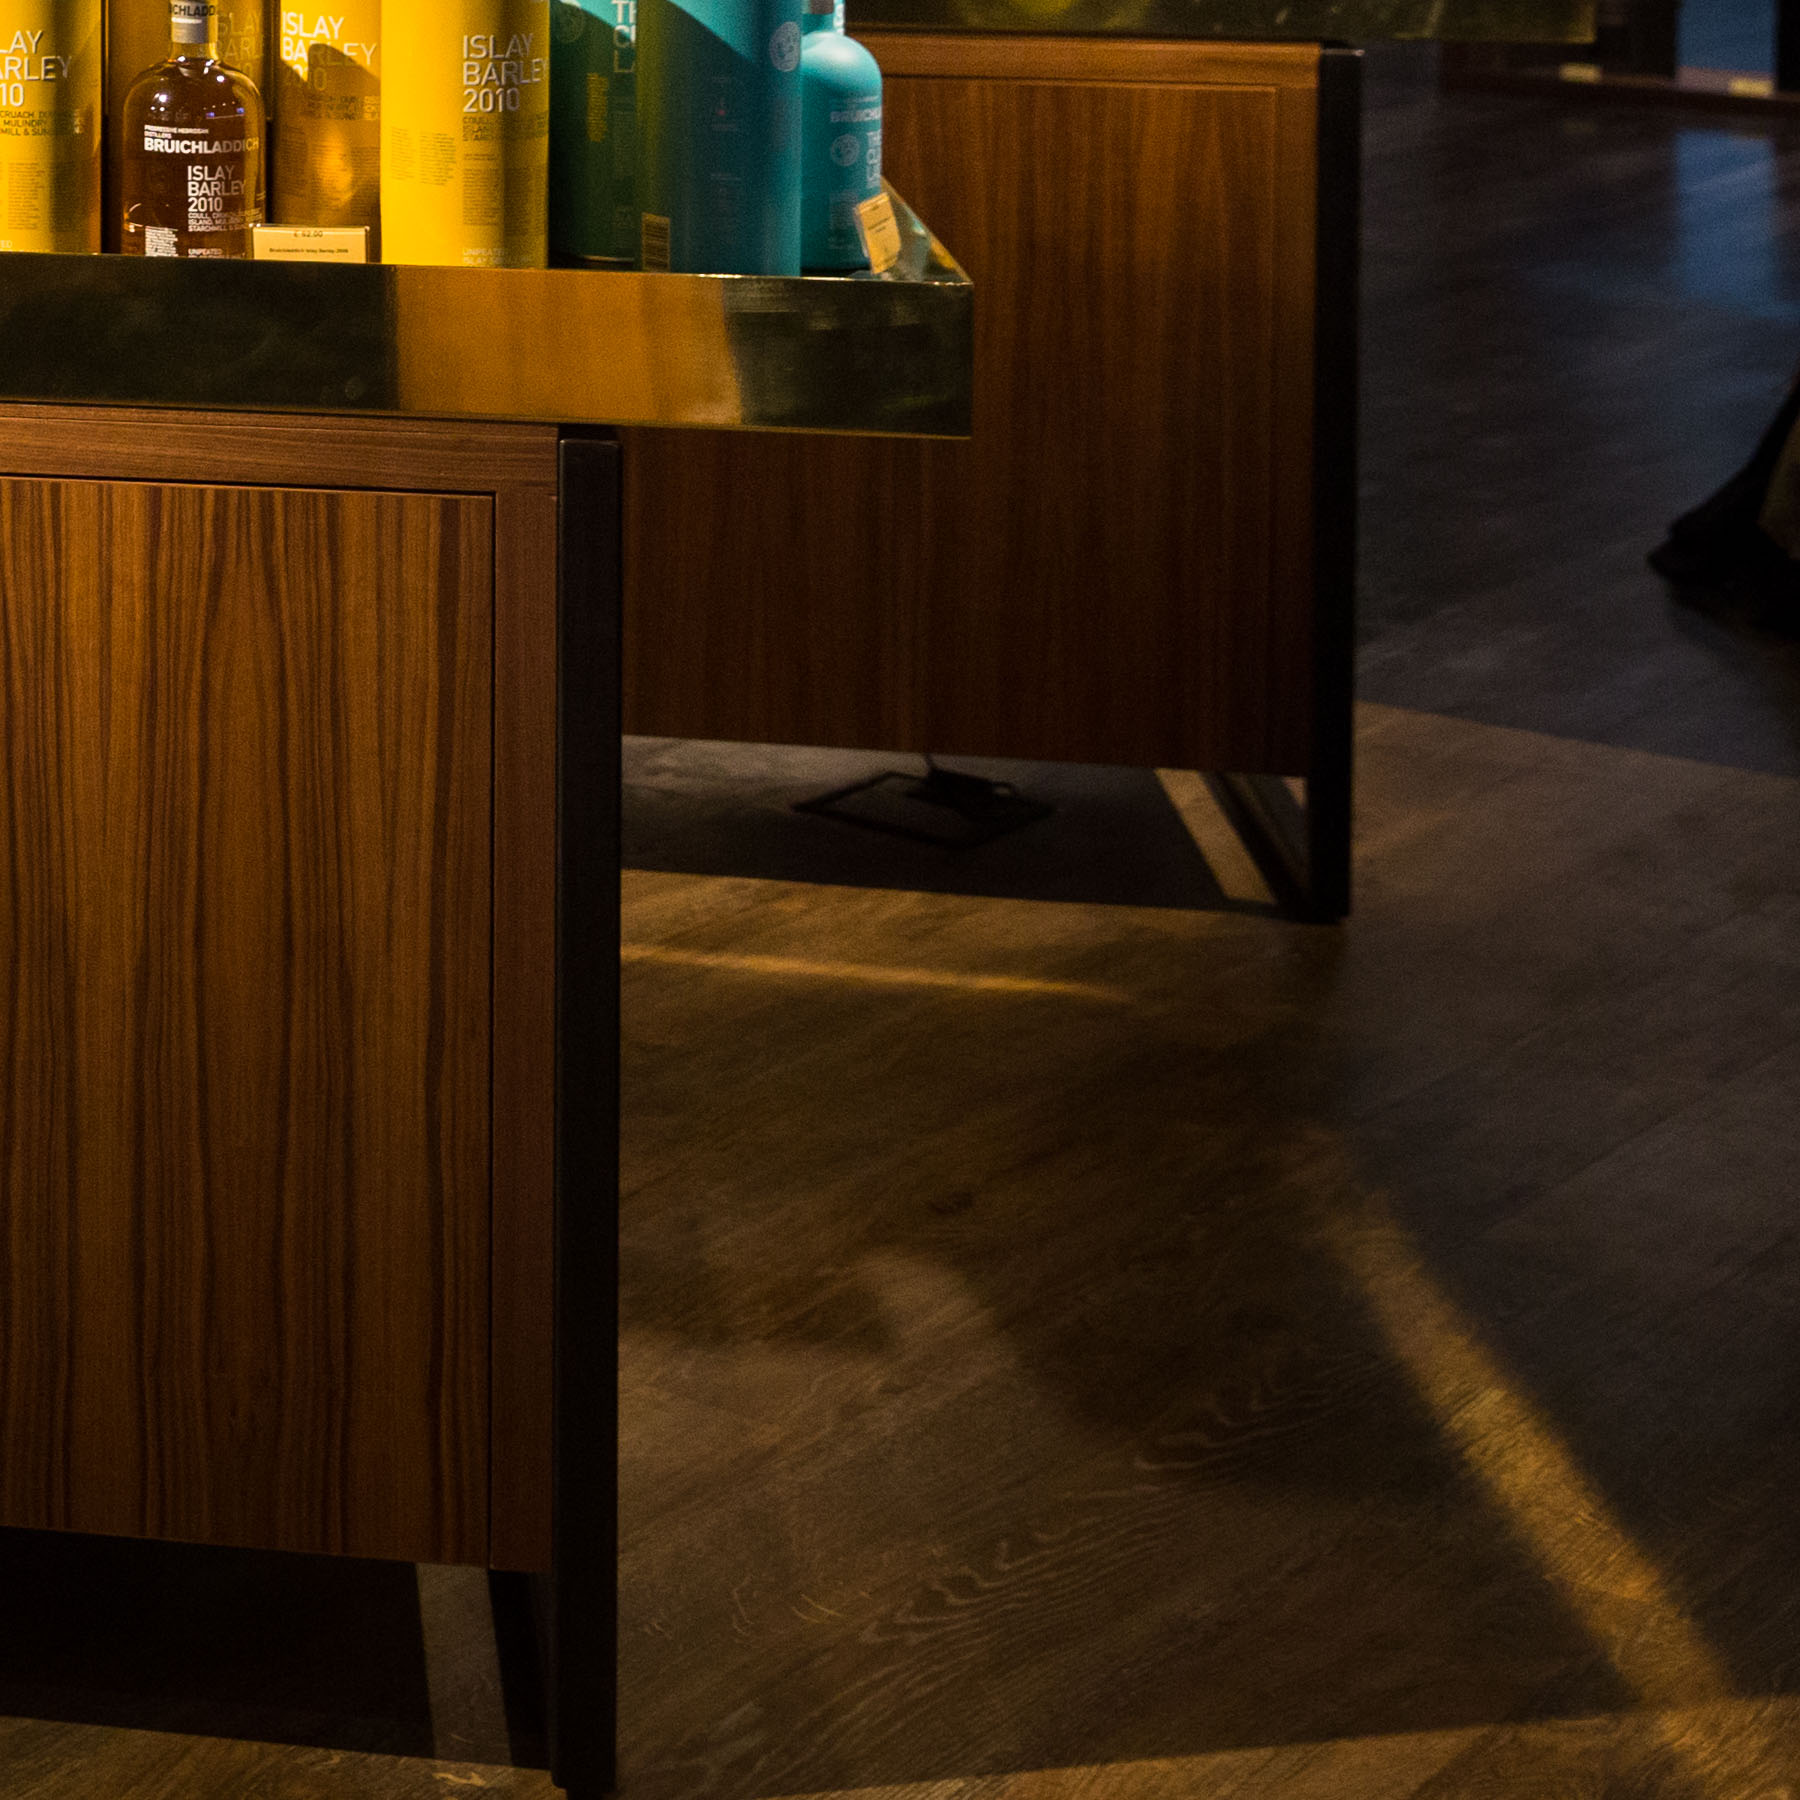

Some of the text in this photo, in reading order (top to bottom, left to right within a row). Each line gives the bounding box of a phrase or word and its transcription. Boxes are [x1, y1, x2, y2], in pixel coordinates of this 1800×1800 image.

[282, 11, 345, 40] ISLAY
[282, 36, 377, 66] BARLEY
[463, 33, 533, 60] ISLAY
[283, 62, 328, 91] 2010
[463, 58, 547, 87] BARLEY
[463, 88, 520, 114] 2010
[144, 137, 259, 154] BRUICHLADDICH
[187, 165, 235, 181] ISLAY
[187, 180, 246, 197] BARLEY
[187, 197, 223, 212] 2010
